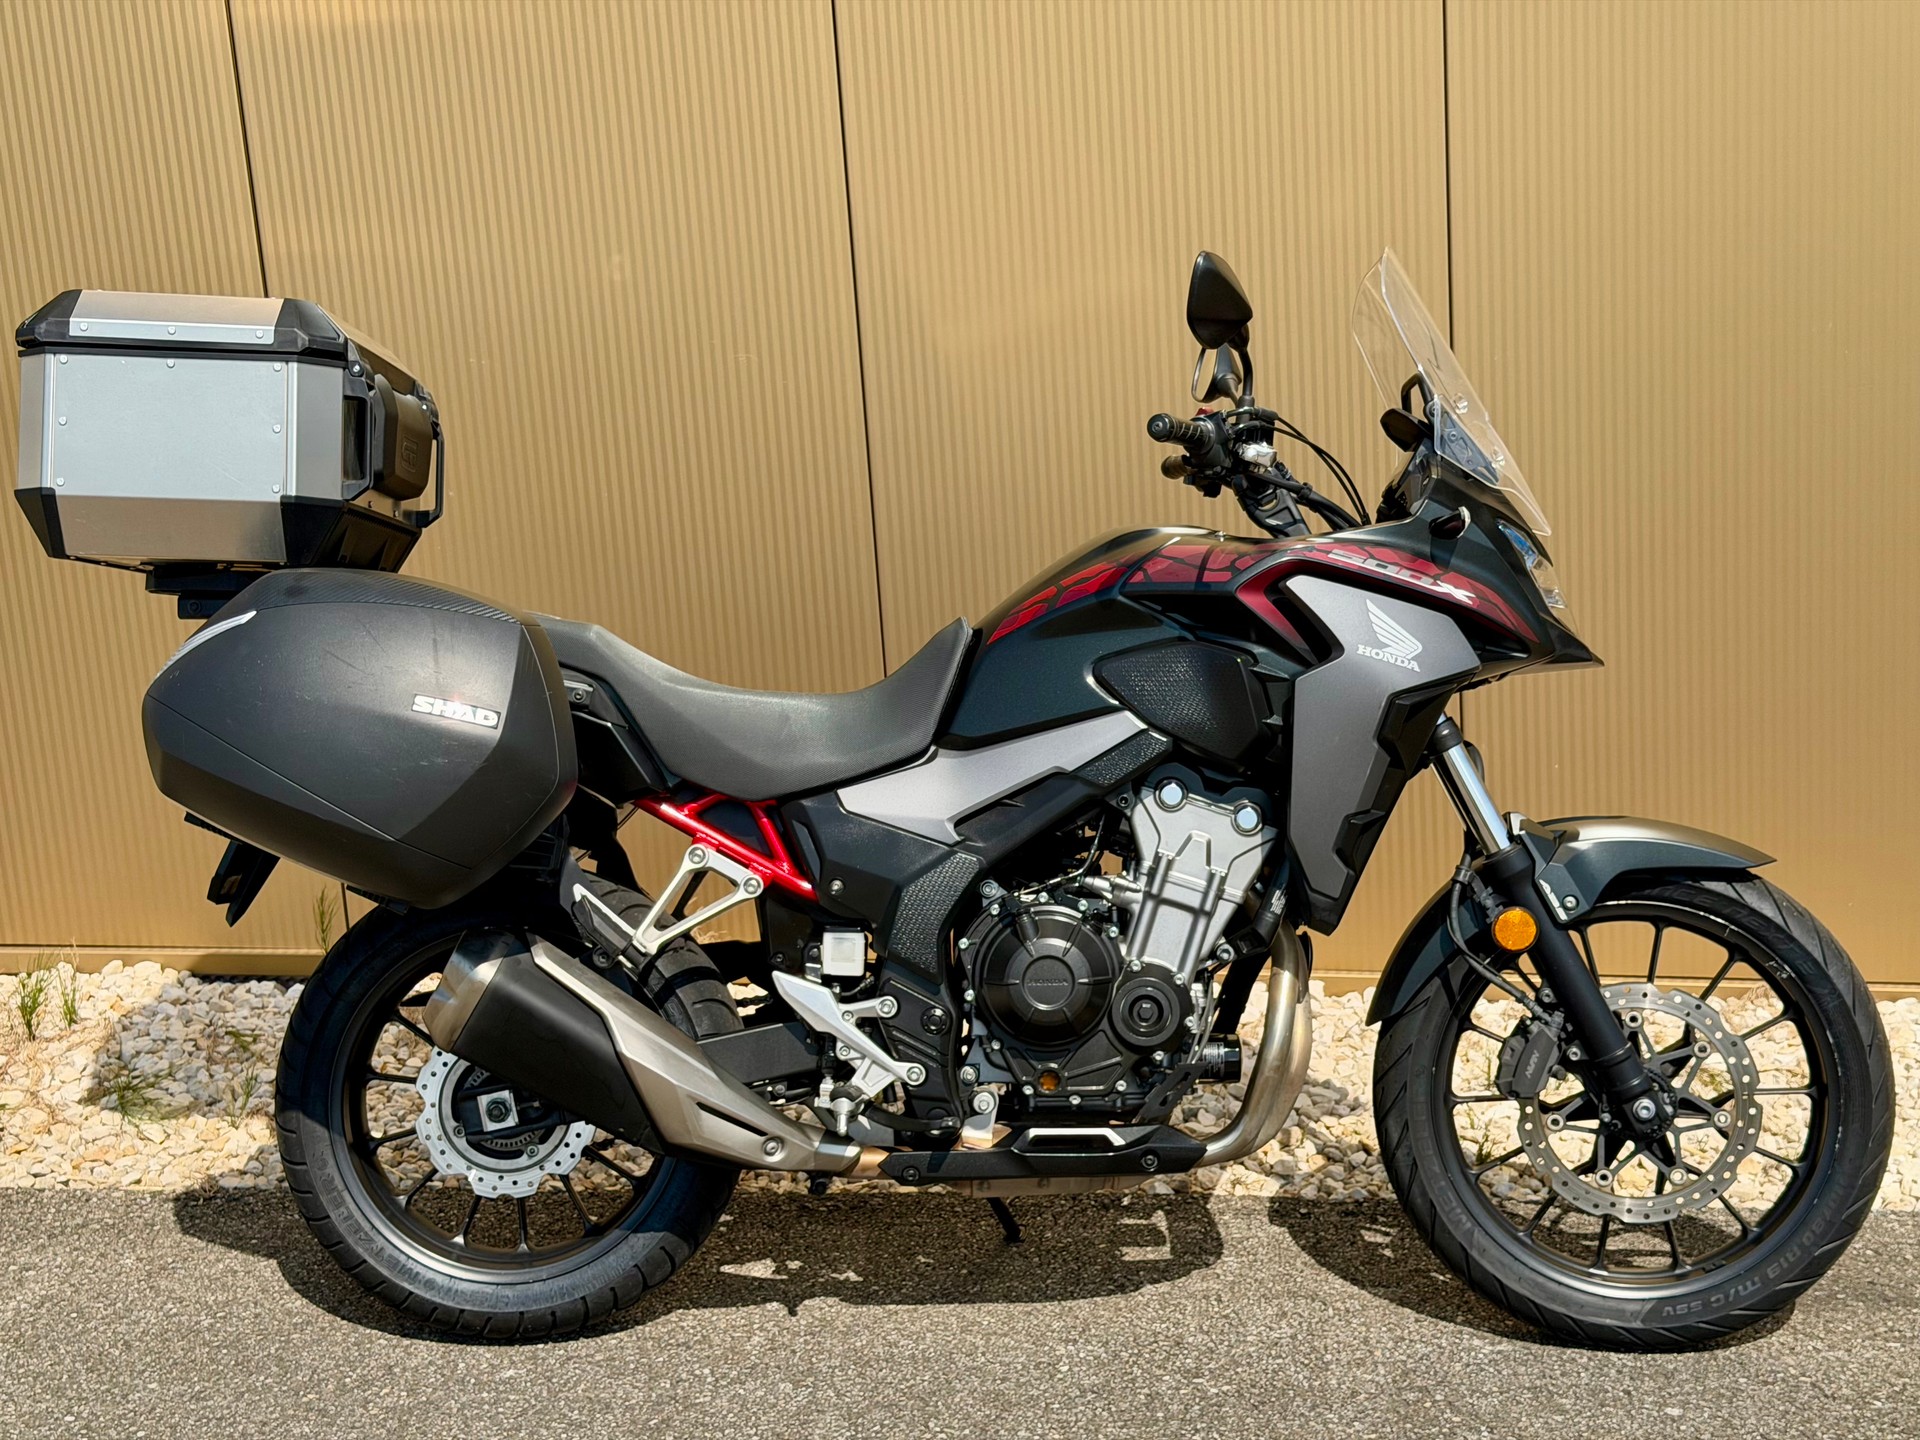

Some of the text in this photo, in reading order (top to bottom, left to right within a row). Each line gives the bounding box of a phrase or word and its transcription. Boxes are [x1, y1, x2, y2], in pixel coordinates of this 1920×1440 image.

[1327, 548, 1477, 605] 500X
[1357, 644, 1421, 672] HONDA
[411, 694, 500, 728] SHAD
[1027, 978, 1069, 986] HONDA
